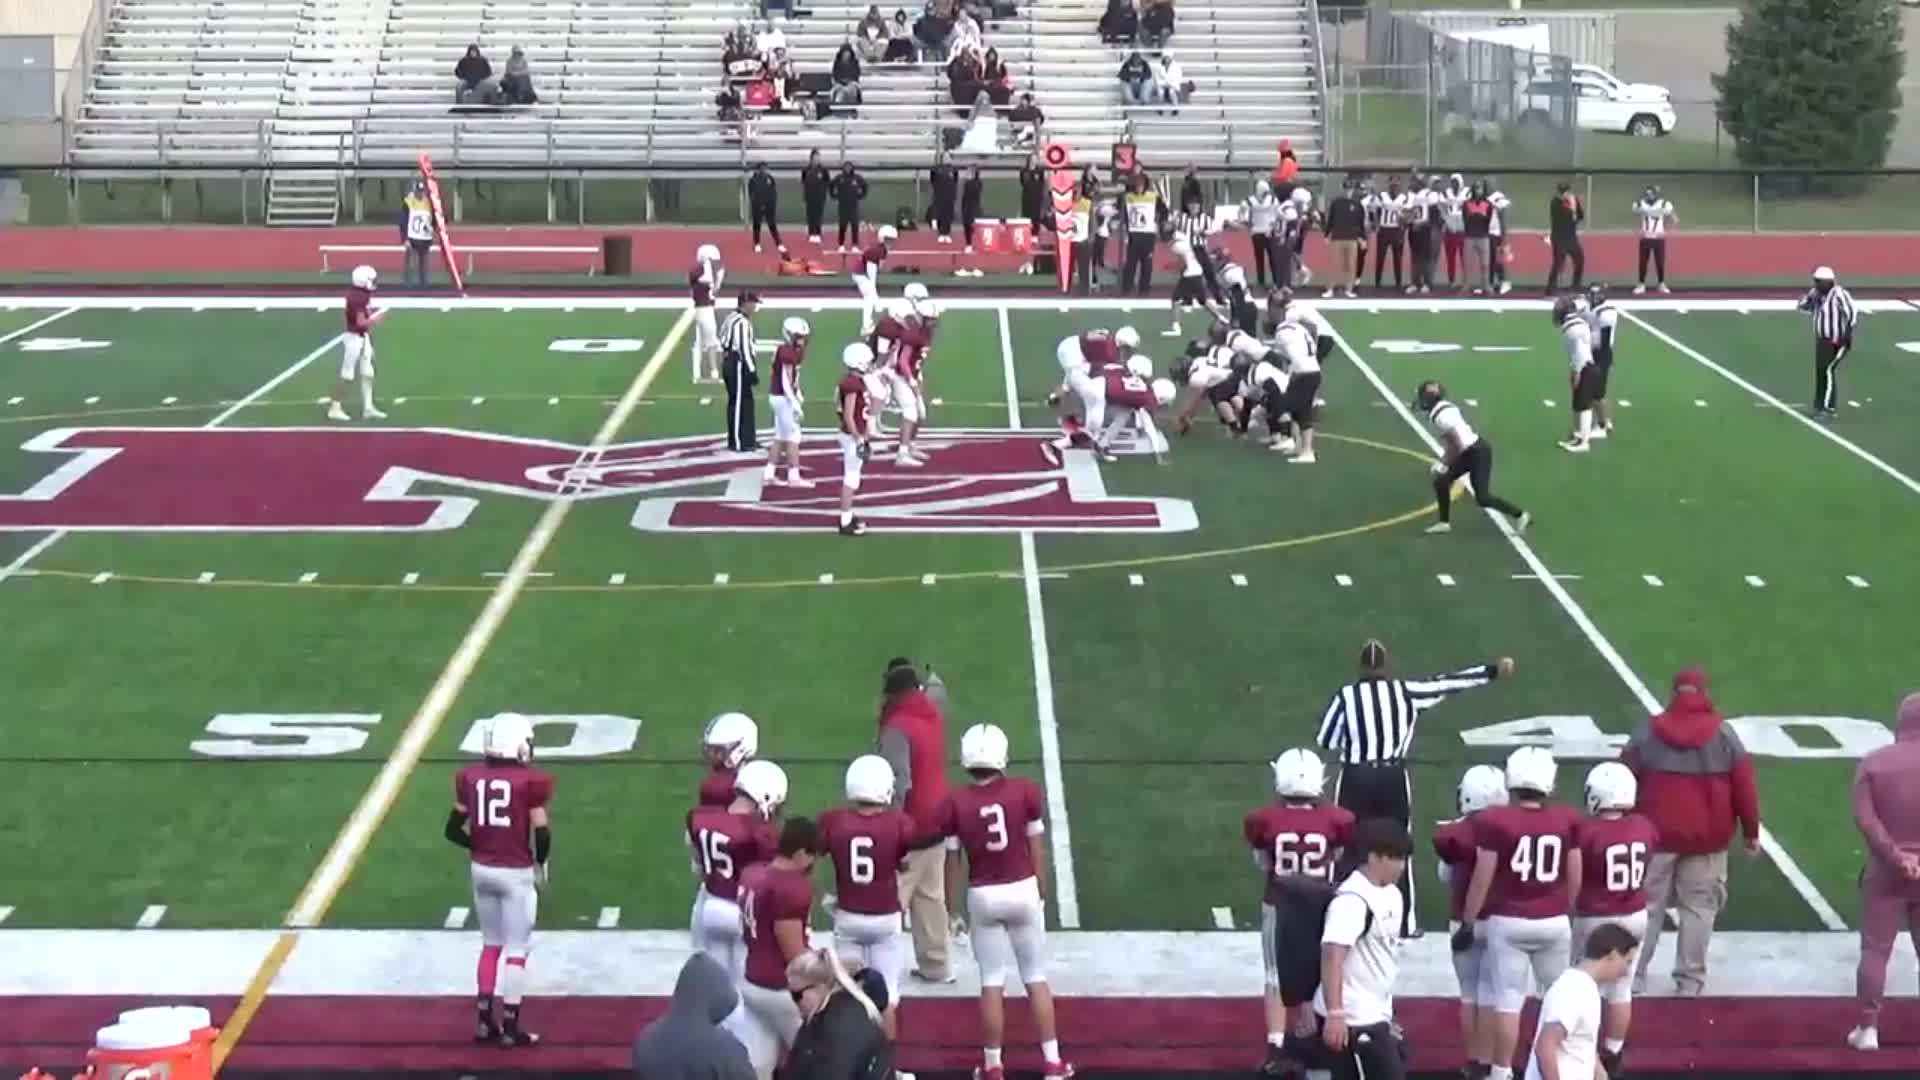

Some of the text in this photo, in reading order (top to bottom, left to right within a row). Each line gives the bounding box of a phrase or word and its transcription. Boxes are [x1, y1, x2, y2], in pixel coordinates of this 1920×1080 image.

[190, 713, 640, 757] 50
[1460, 714, 1896, 758] 40
[476, 779, 511, 828] 12
[979, 804, 1009, 852] 3
[699, 828, 734, 881] 15
[850, 836, 874, 883] 6
[1273, 832, 1329, 877] 62
[1510, 835, 1562, 883] 40
[1605, 843, 1647, 892] 66
